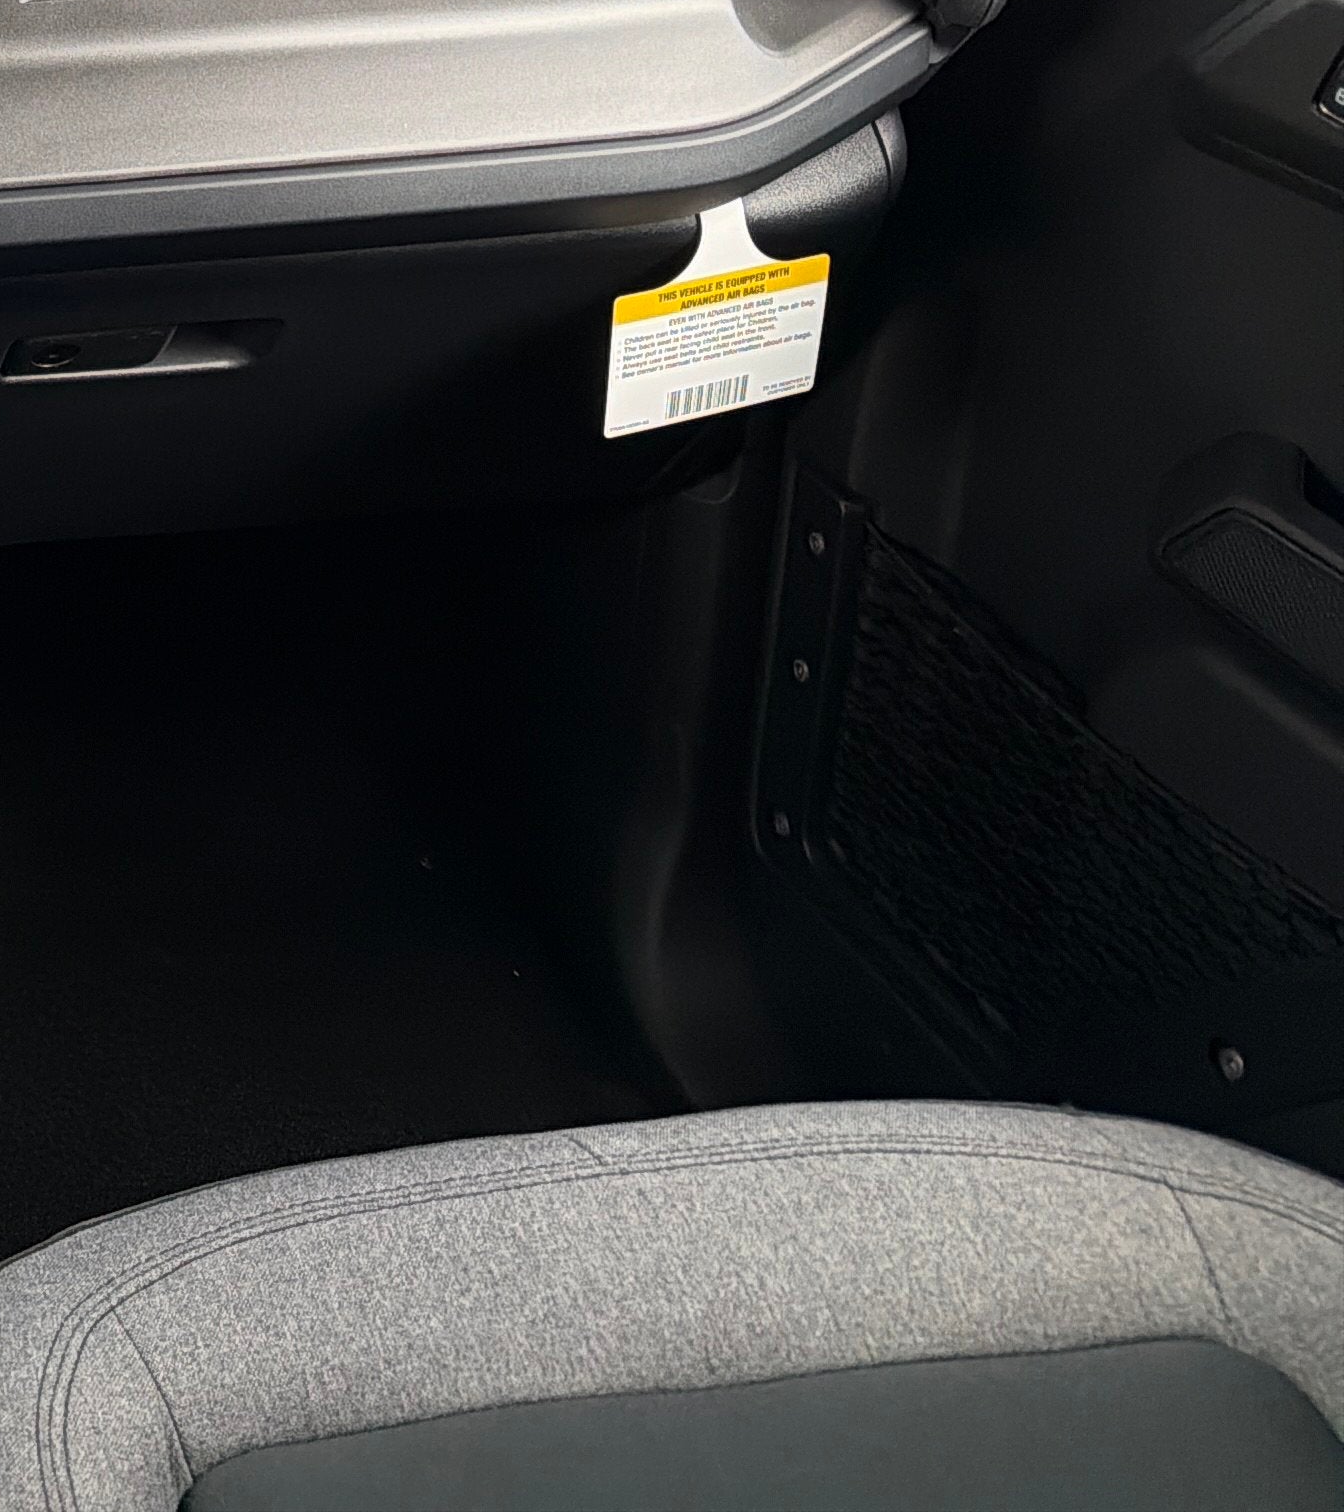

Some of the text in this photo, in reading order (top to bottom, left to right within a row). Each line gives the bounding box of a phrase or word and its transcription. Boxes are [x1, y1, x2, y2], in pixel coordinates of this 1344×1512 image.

[658, 267, 790, 303] THIS VEHICLE IS EQUIPPED WITH
[680, 284, 765, 311] ADVANCED AIR BAGS
[707, 305, 741, 319] ADVANCED
[743, 302, 754, 311] AIR
[756, 297, 774, 308] BAGS
